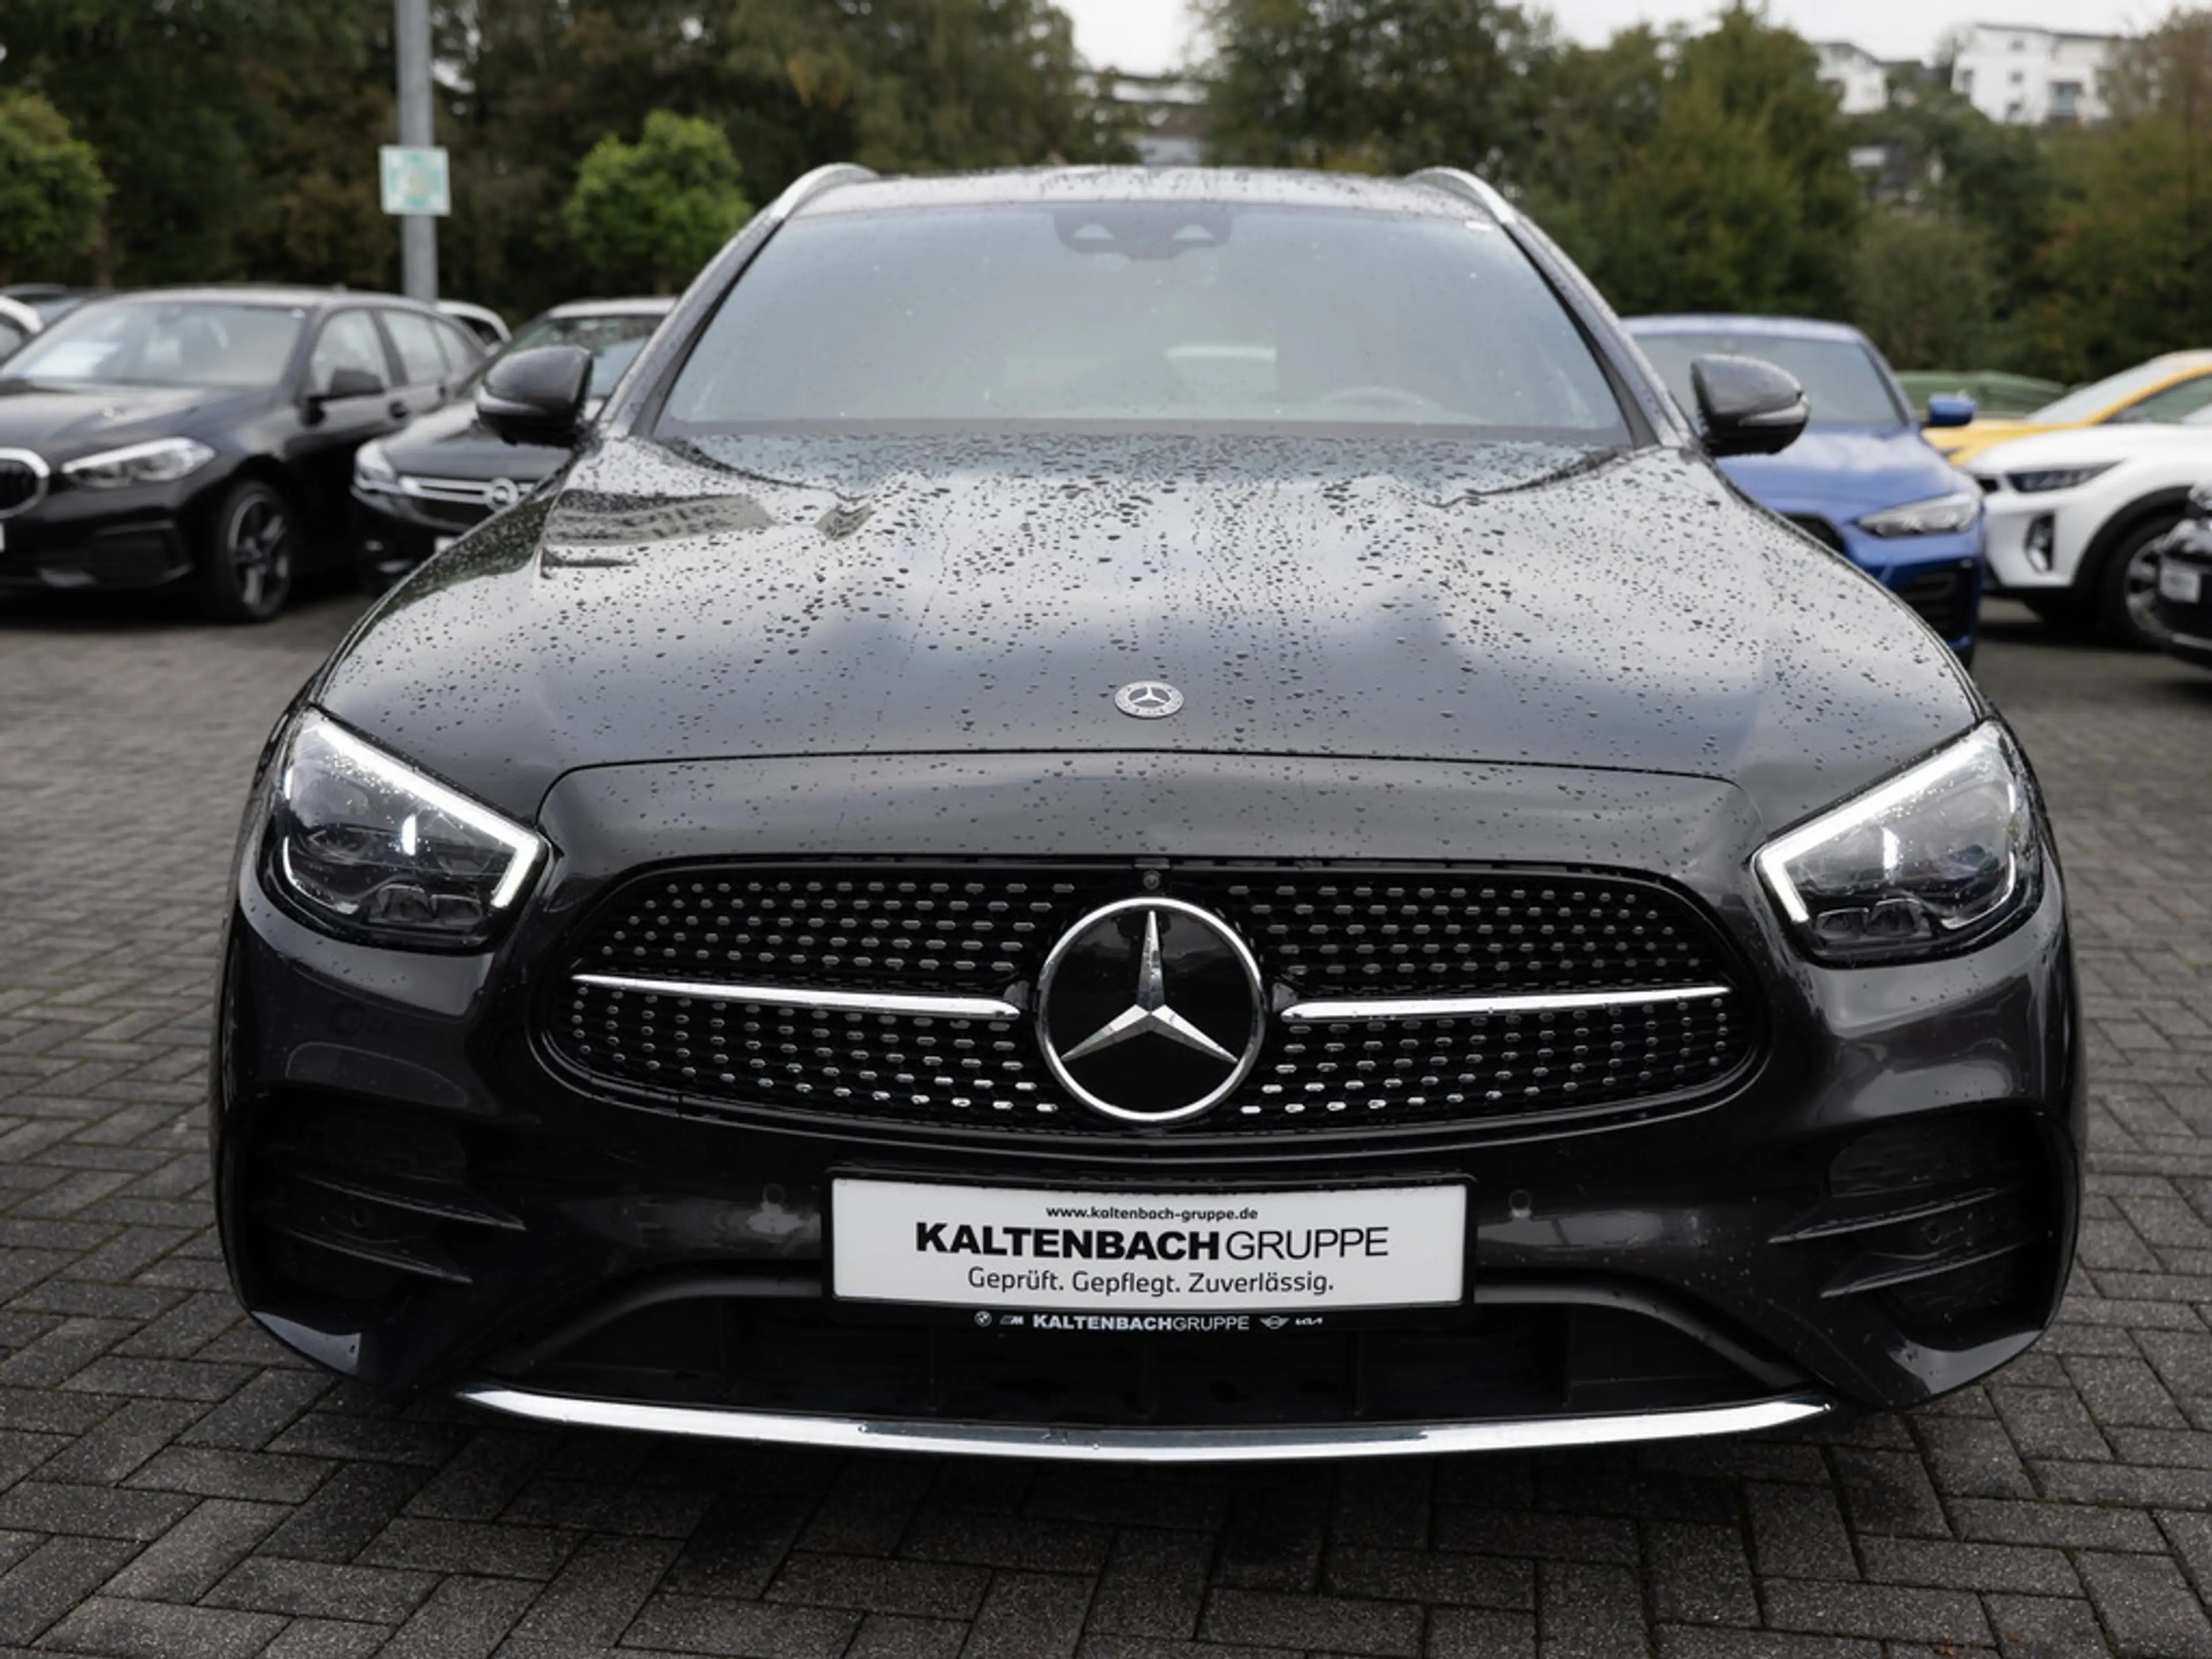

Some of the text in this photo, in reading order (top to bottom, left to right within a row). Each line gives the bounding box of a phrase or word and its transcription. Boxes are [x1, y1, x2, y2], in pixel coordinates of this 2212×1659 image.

[1046, 1206, 1258, 1224] www.kaltenbach-gruppe.de
[916, 1221, 1389, 1261] KALTENBACHGRUPPE
[968, 1266, 1334, 1297] Geprüft. Gepflegt. Zuverlässig.
[1032, 1314, 1249, 1331] KALTENBACHGRUPPE
